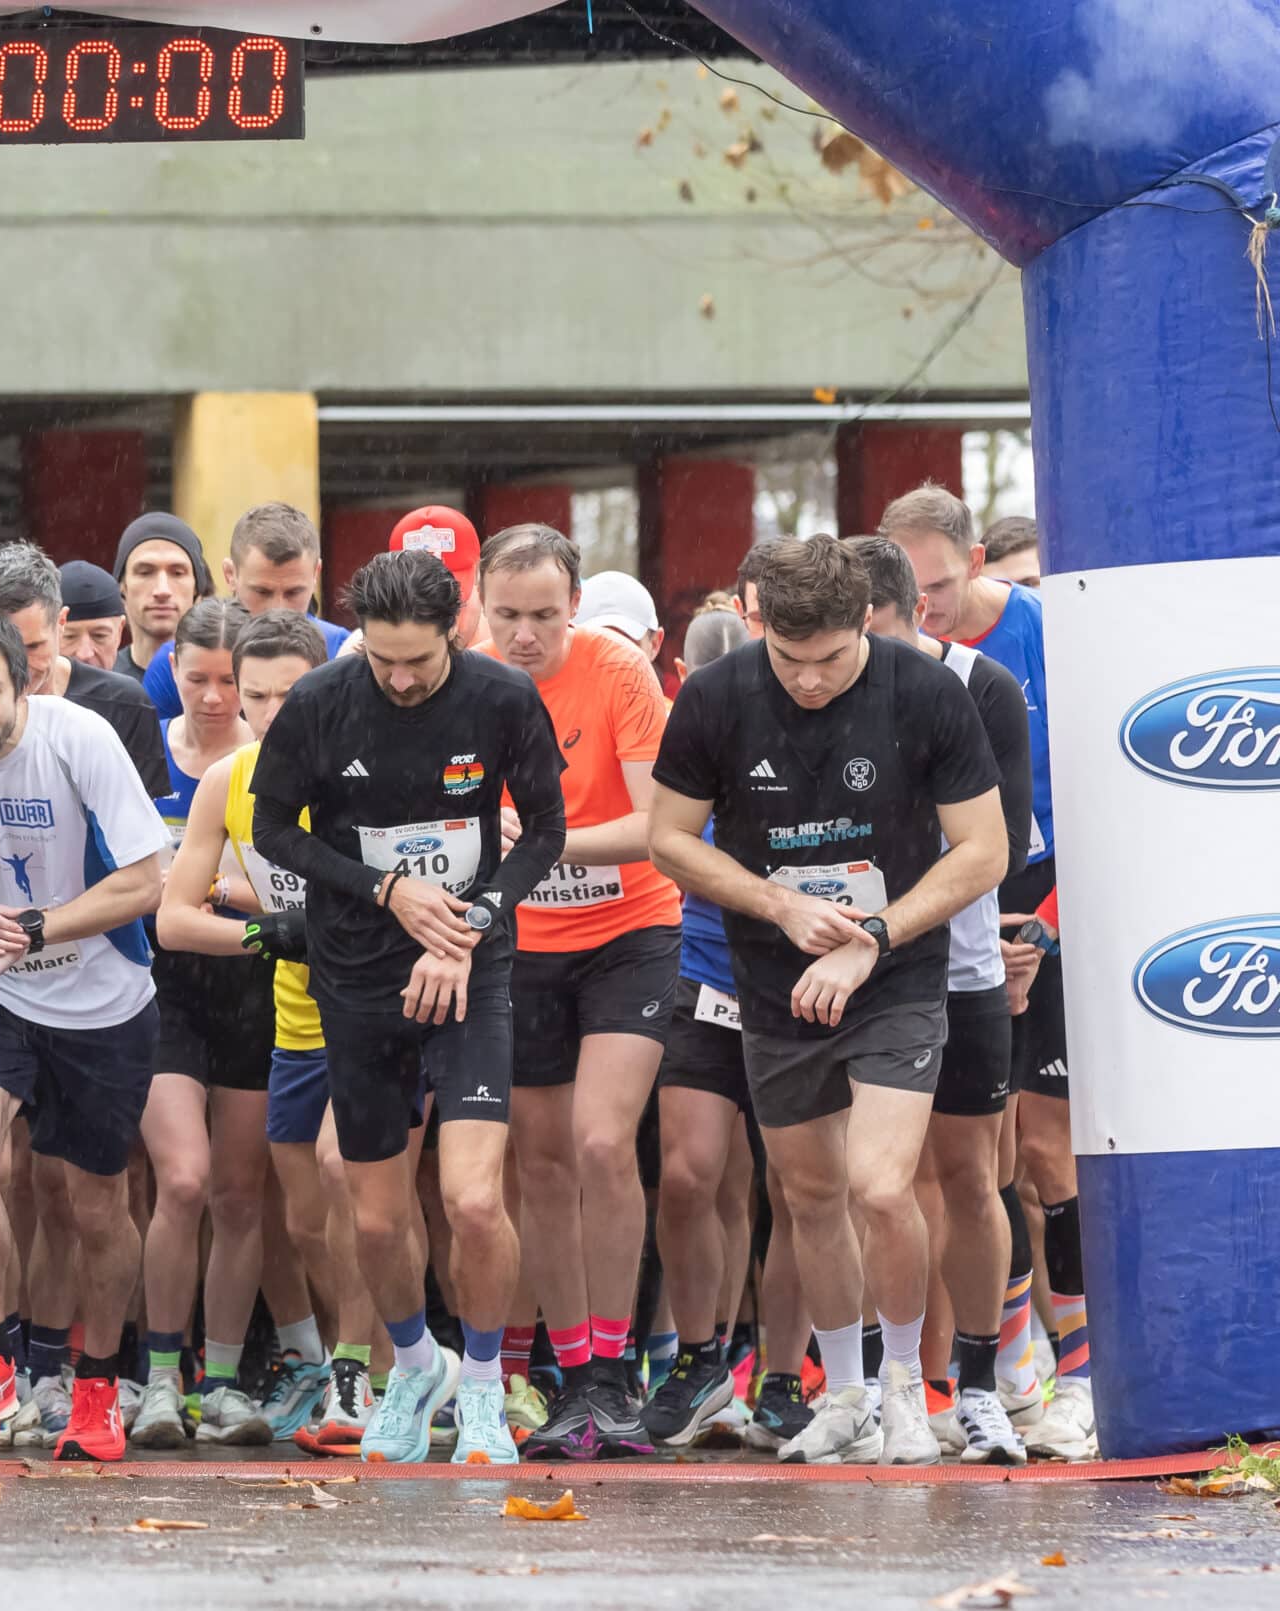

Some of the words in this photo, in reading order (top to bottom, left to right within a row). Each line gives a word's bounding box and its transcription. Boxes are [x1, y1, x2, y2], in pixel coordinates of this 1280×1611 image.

[1169, 688, 1280, 770] Fo
[3, 799, 49, 824] DÜRR
[770, 823, 874, 849] GENERATION
[798, 820, 835, 836] NEXT
[402, 840, 435, 854] Ford
[393, 853, 450, 878] 410
[270, 873, 305, 893] 69
[441, 875, 475, 895] kas
[529, 882, 621, 903] hristian
[806, 881, 838, 894] Ford
[8, 951, 79, 975] n-Marc
[1183, 935, 1280, 1017] Fo
